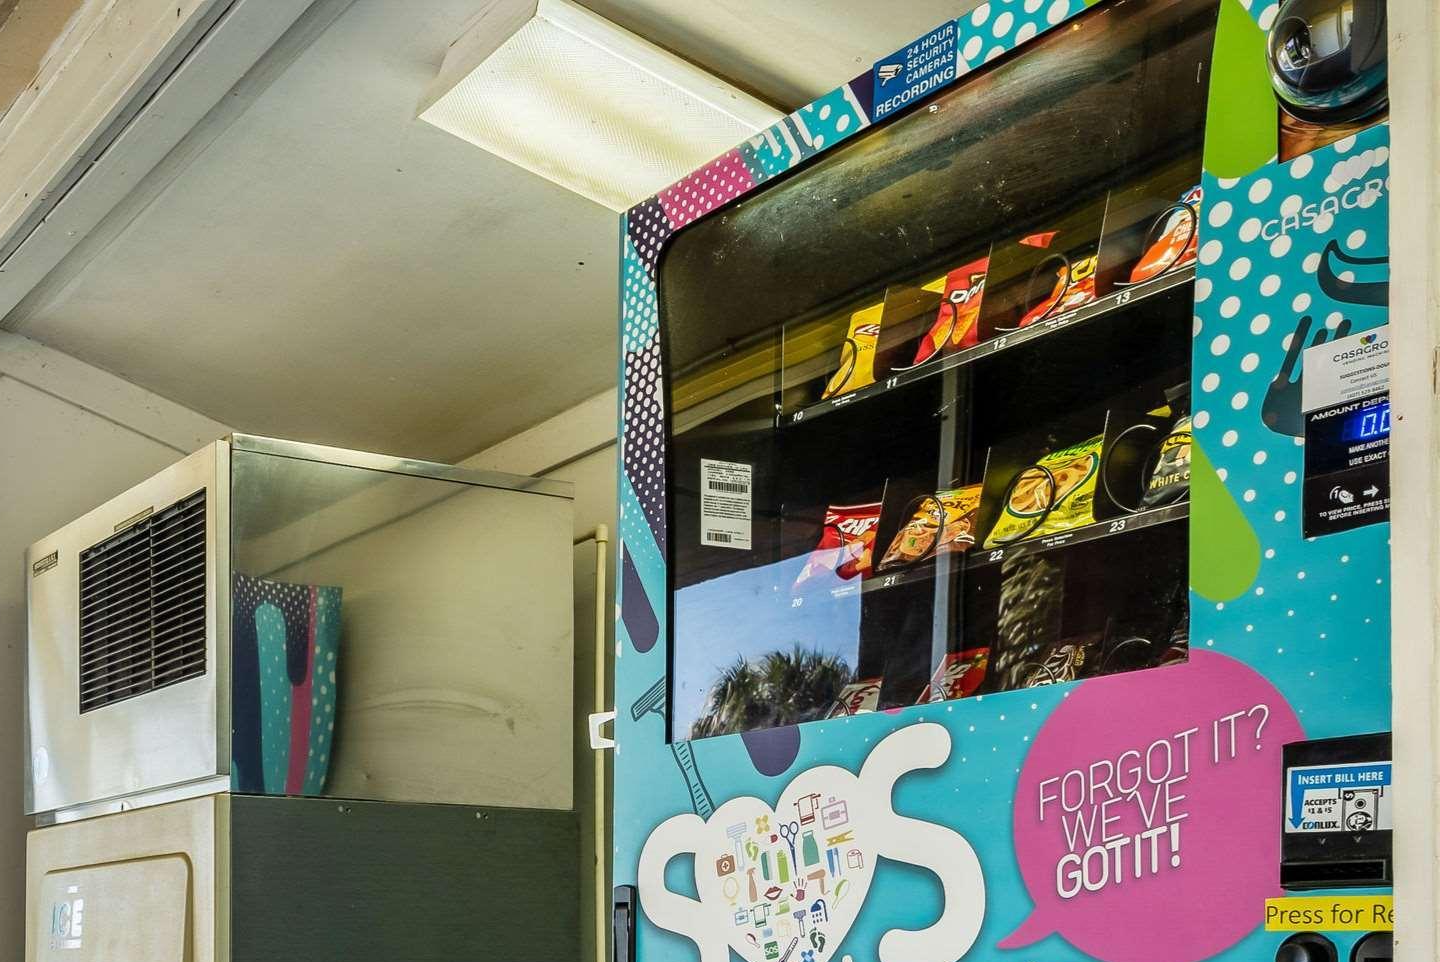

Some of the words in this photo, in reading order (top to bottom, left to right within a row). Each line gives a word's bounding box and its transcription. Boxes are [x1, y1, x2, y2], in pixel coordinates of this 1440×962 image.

[906, 44, 919, 59] 24
[921, 24, 954, 51] HOUR
[906, 36, 955, 71] SECURITY
[905, 50, 954, 84] CAMERAS
[875, 65, 954, 118] RECORDING
[1260, 176, 1390, 242] CASAGR
[1115, 291, 1132, 306] 13
[993, 337, 1008, 351] 12
[885, 376, 899, 390] 11
[792, 410, 805, 422] 10
[1310, 402, 1360, 422] AMOUNT
[1362, 395, 1390, 410] DEP
[1349, 457, 1363, 466] USE
[1364, 451, 1388, 463] EXACT
[1151, 472, 1181, 489] WHITE
[1328, 508, 1343, 517] VIEW
[1363, 500, 1384, 509] PRESS
[1328, 511, 1353, 521] BEFORE
[1353, 504, 1384, 516] INSERTING
[1109, 519, 1127, 533] 23
[988, 549, 1004, 562] 22
[883, 574, 897, 587] 21
[791, 596, 804, 609] 20
[1039, 727, 1200, 822] FORGOT
[1213, 704, 1270, 764] IT?
[1297, 774, 1333, 785] INSERT
[1334, 772, 1356, 783] BILL
[1358, 770, 1384, 782] HERE
[1304, 798, 1338, 806] ACCEPTS
[1061, 774, 1189, 853] WE'VE
[1056, 836, 1131, 899] GOT
[1134, 822, 1181, 879] IT!
[1265, 904, 1324, 925] Press
[1330, 902, 1365, 924] for
